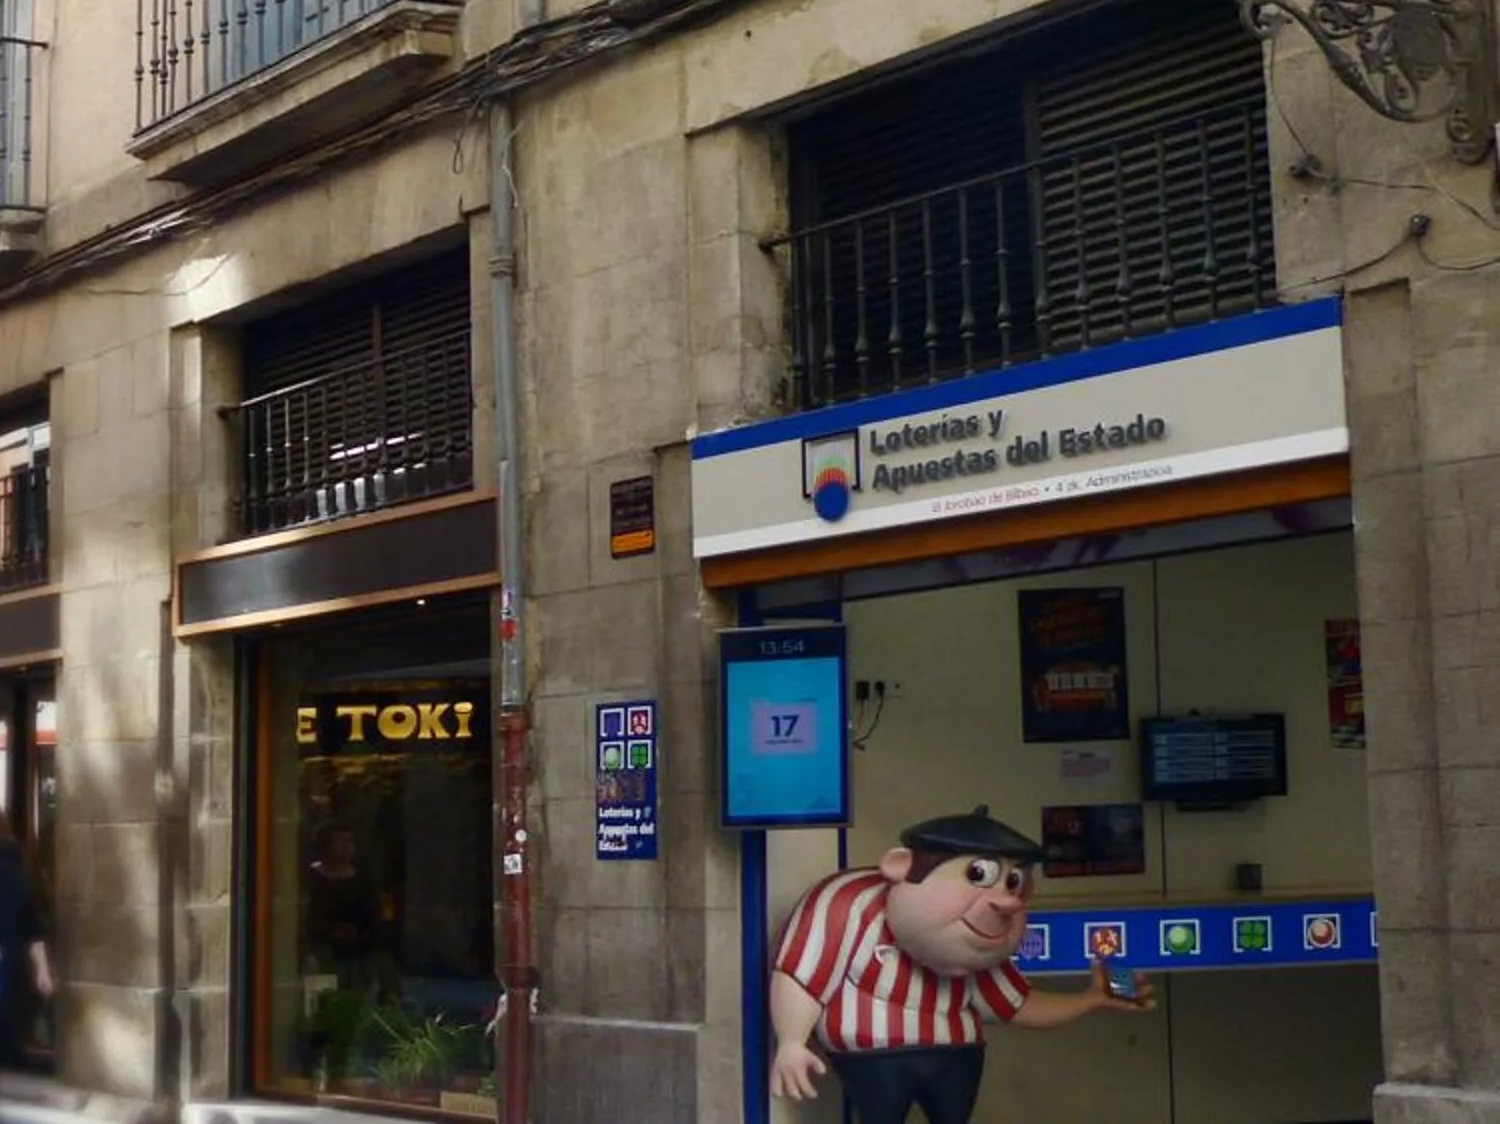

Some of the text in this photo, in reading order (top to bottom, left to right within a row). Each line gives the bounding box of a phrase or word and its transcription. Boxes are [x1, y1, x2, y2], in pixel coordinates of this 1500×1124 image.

[870, 409, 1003, 455] Loterías y
[872, 413, 1166, 493] Apuestas del Estado
[760, 640, 804, 654] 13:54
[771, 714, 800, 738] 17
